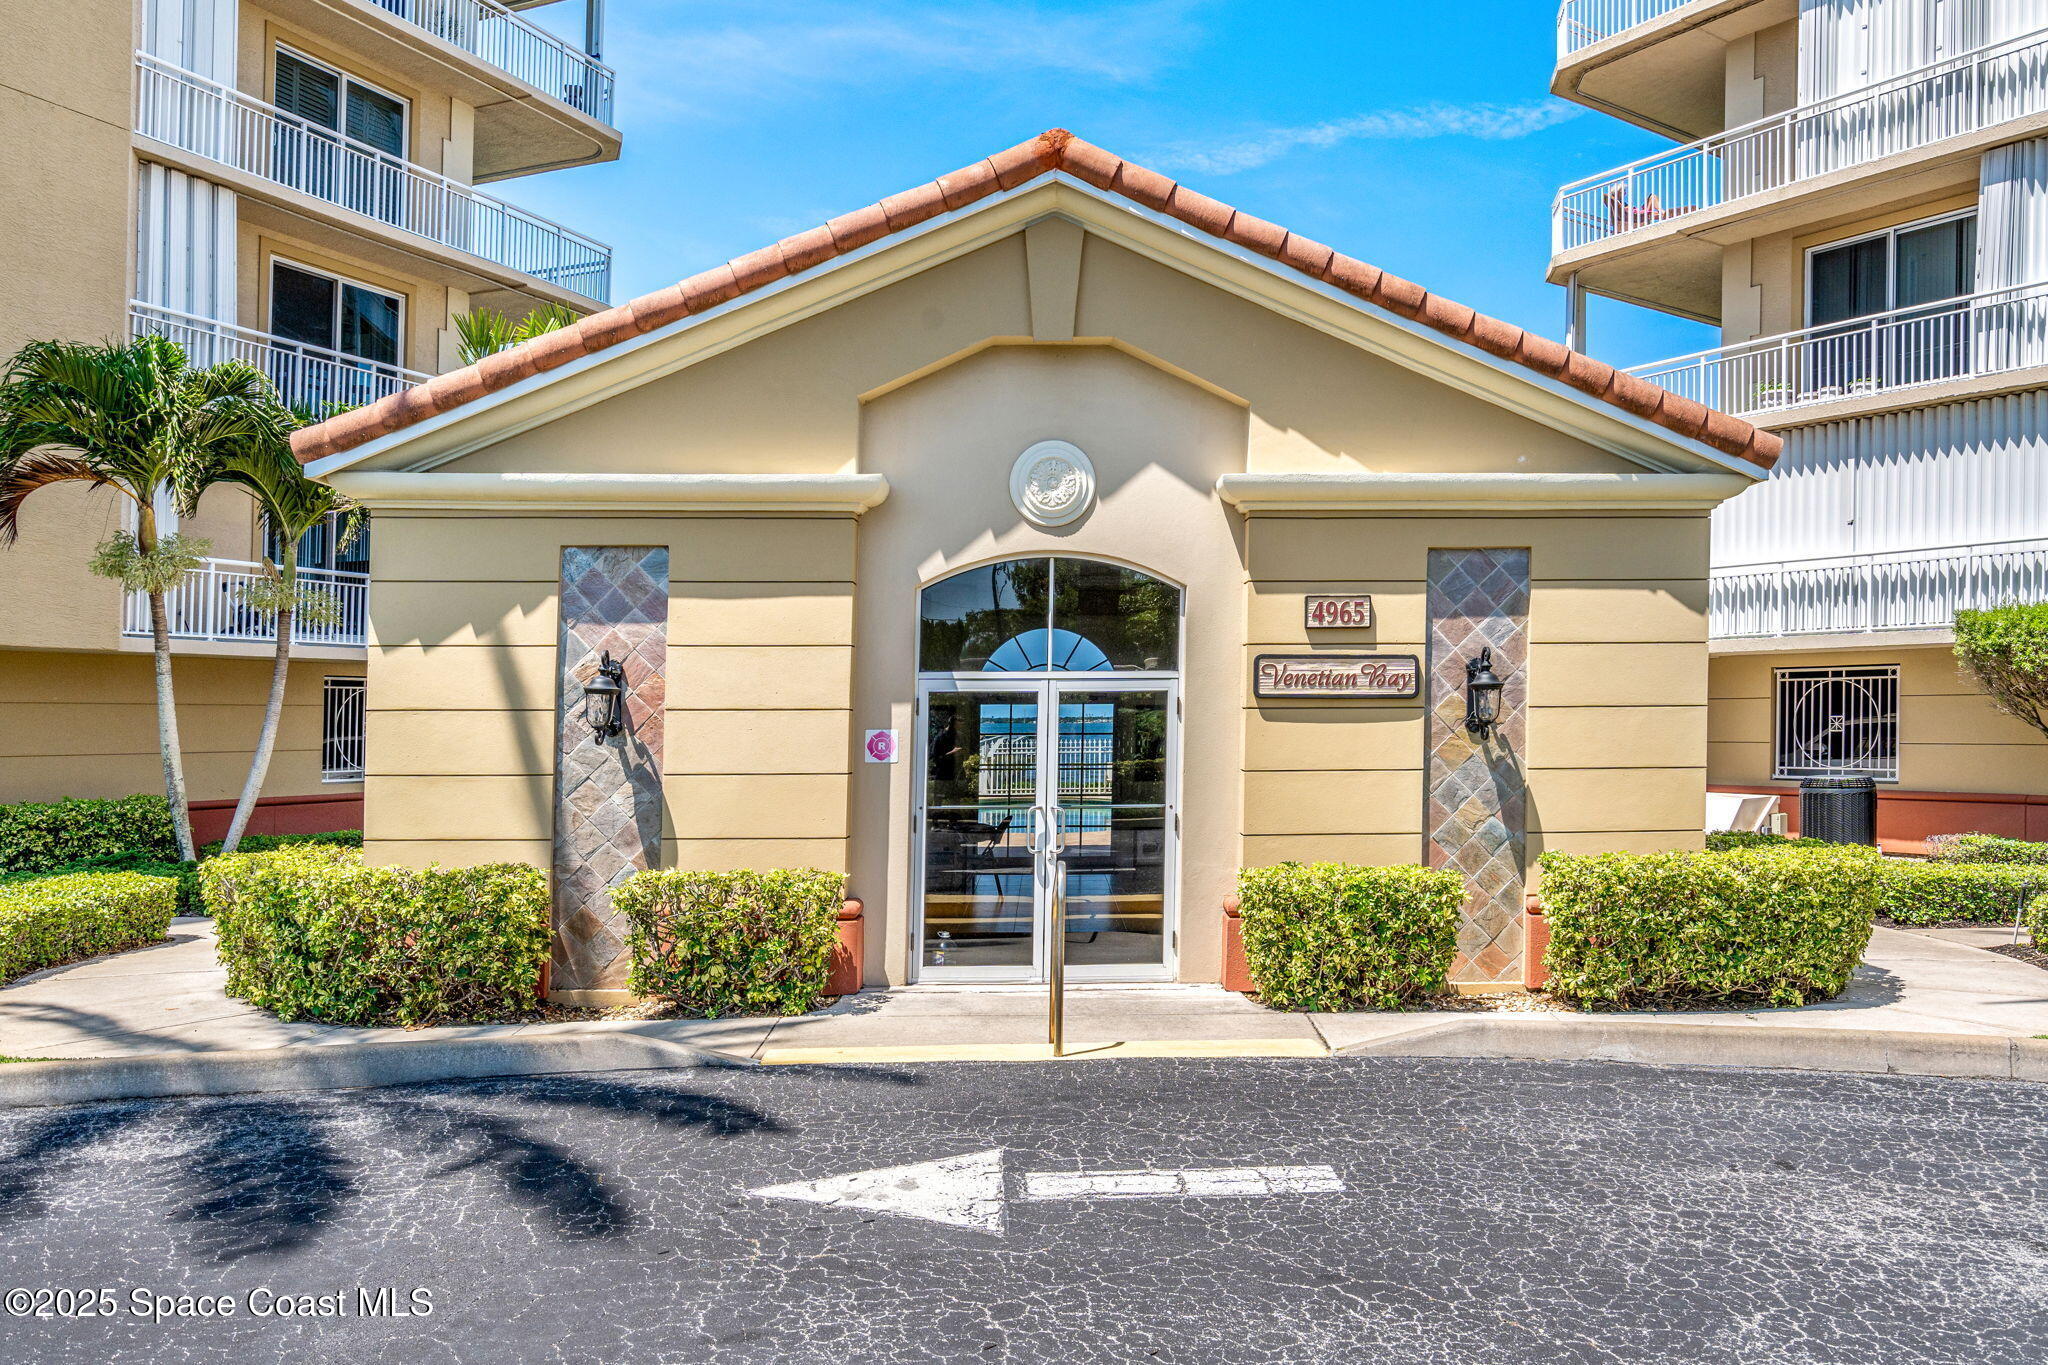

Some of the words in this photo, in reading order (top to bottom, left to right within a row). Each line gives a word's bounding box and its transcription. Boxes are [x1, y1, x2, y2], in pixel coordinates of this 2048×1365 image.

[1311, 600, 1366, 625] 4965
[1260, 663, 1358, 688] Venetian
[1360, 663, 1412, 692] Bay
[878, 741, 886, 750] R
